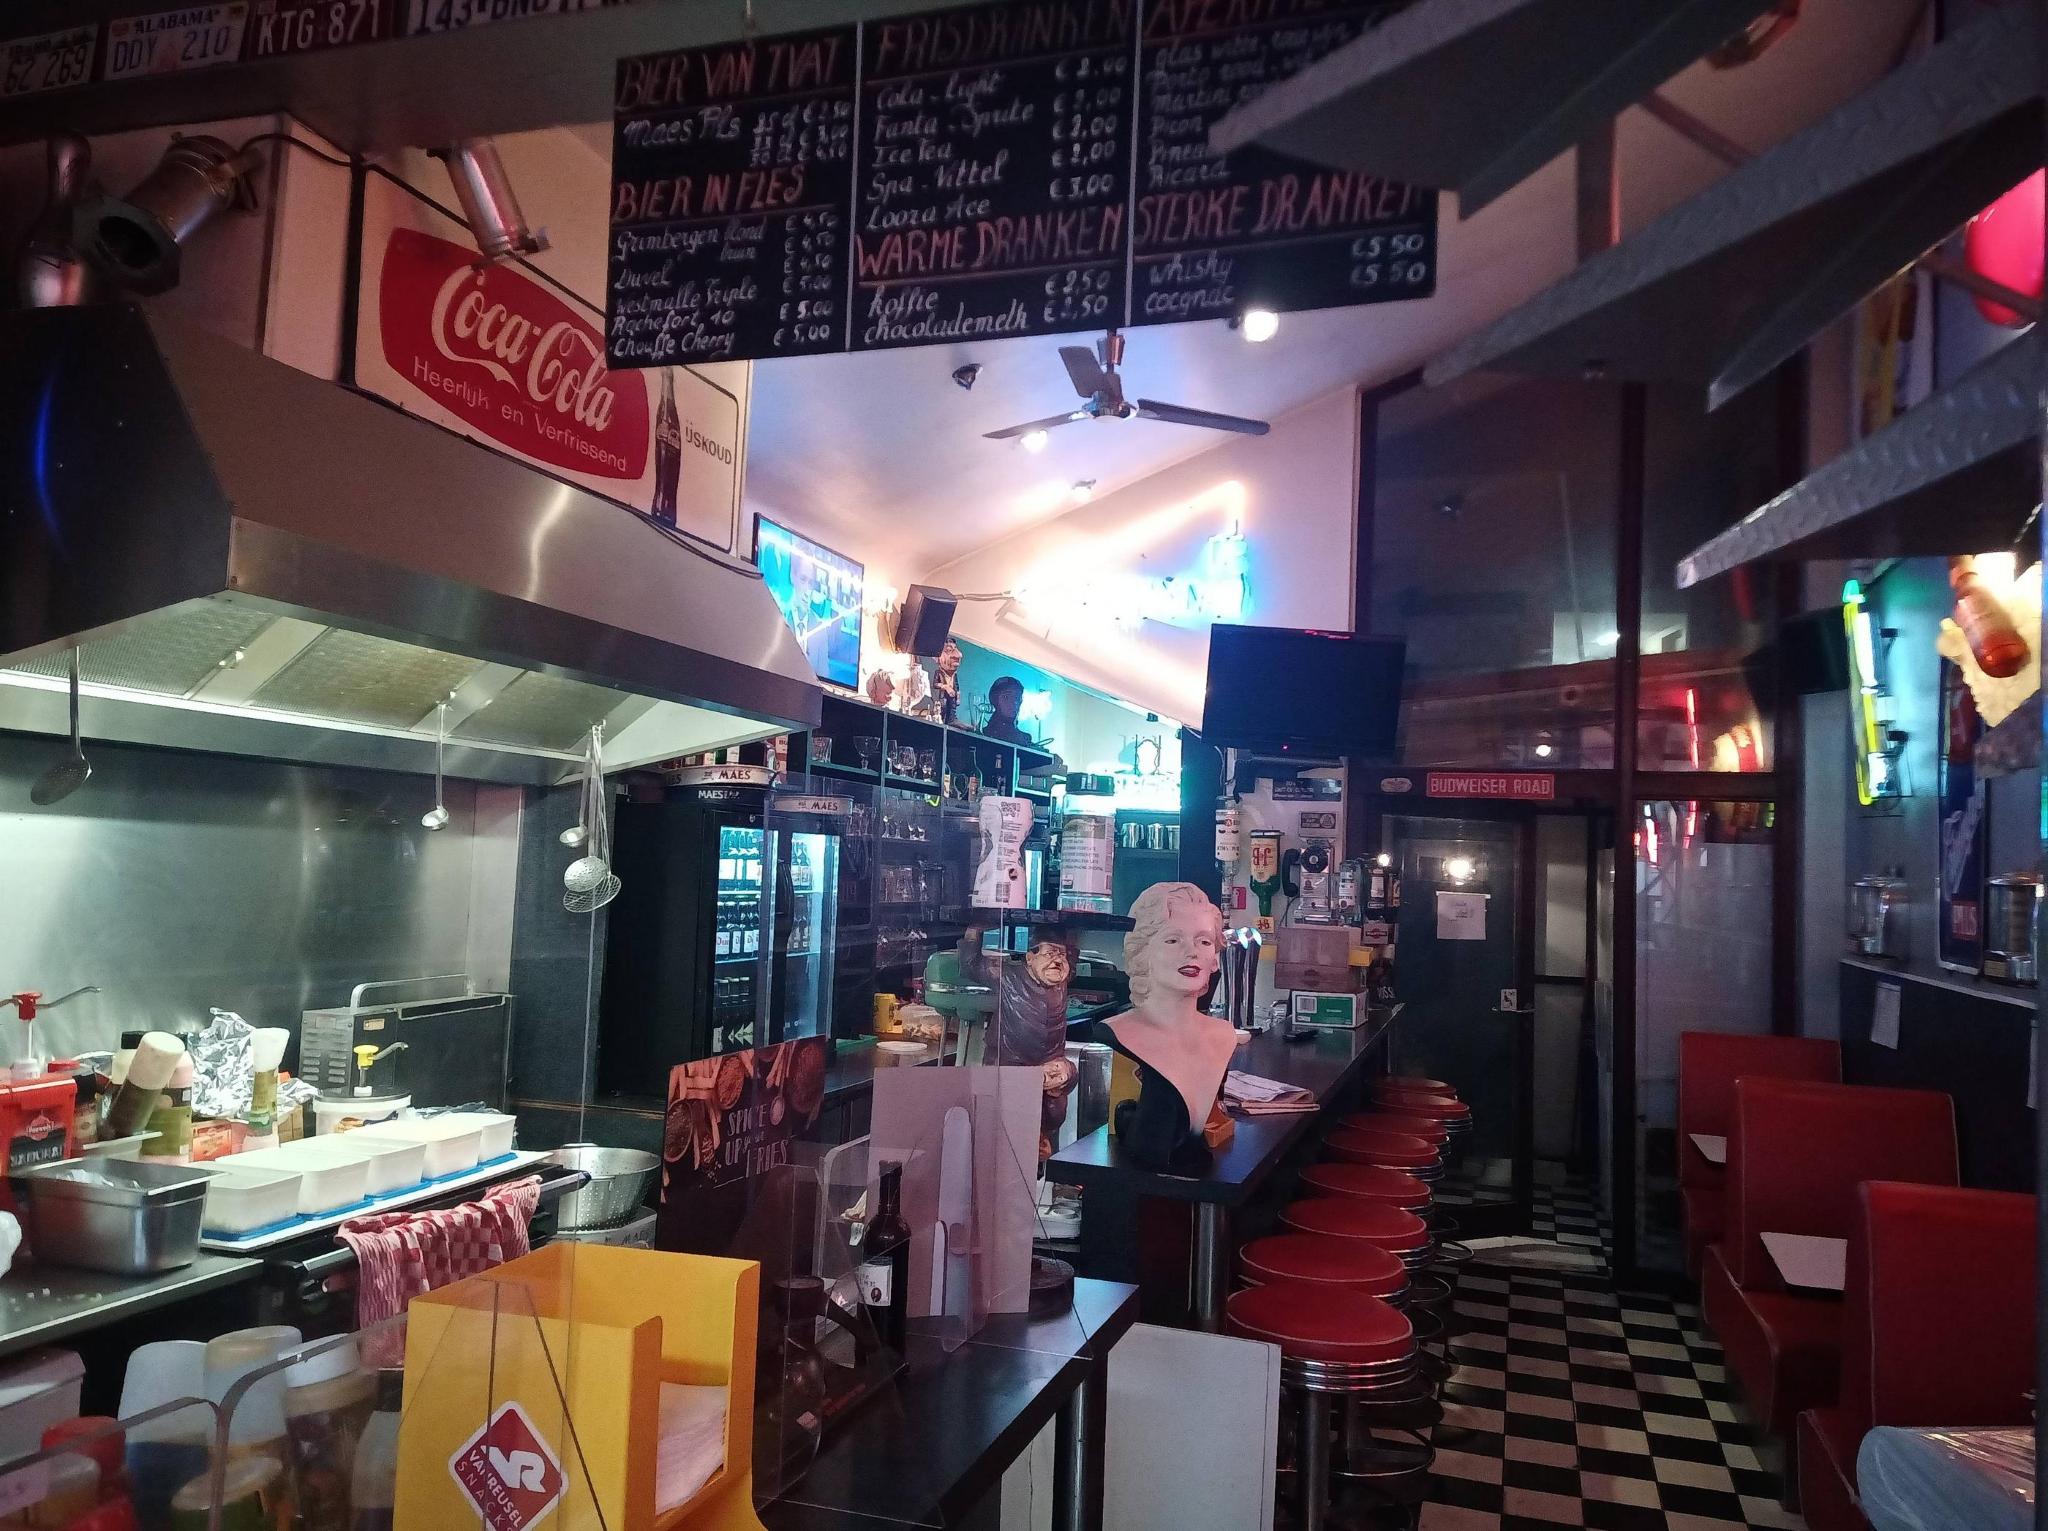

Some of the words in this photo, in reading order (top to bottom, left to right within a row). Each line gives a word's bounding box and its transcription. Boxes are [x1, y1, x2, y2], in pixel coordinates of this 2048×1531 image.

[135, 8, 213, 34] ALABAMA
[257, 8, 315, 56] KTG
[327, 0, 379, 45] 871
[43, 45, 87, 87] 269
[113, 38, 157, 73] DDY
[182, 26, 230, 61] 210
[616, 54, 688, 112] BIER
[703, 46, 757, 98] VAN
[874, 111, 938, 142] Fanta
[614, 176, 692, 221] BIER
[736, 165, 804, 210] FLES
[1135, 185, 1249, 244] STERKE
[612, 226, 719, 261] Grimbergen
[856, 225, 968, 277] WARME
[970, 203, 1124, 268] DRANKEN
[615, 259, 673, 289] Duvel
[431, 263, 616, 433] Coca-Cola
[614, 333, 675, 360] Chouffe
[413, 355, 489, 411] Heerlijk
[501, 403, 524, 426] en
[534, 412, 627, 473] Verfrissend
[719, 770, 752, 780] MAES
[1431, 778, 1507, 793] BUDWEISER
[1513, 779, 1551, 795] ROAD
[698, 790, 724, 800] MAES
[811, 802, 838, 812] MAES
[725, 1138, 743, 1166] UP
